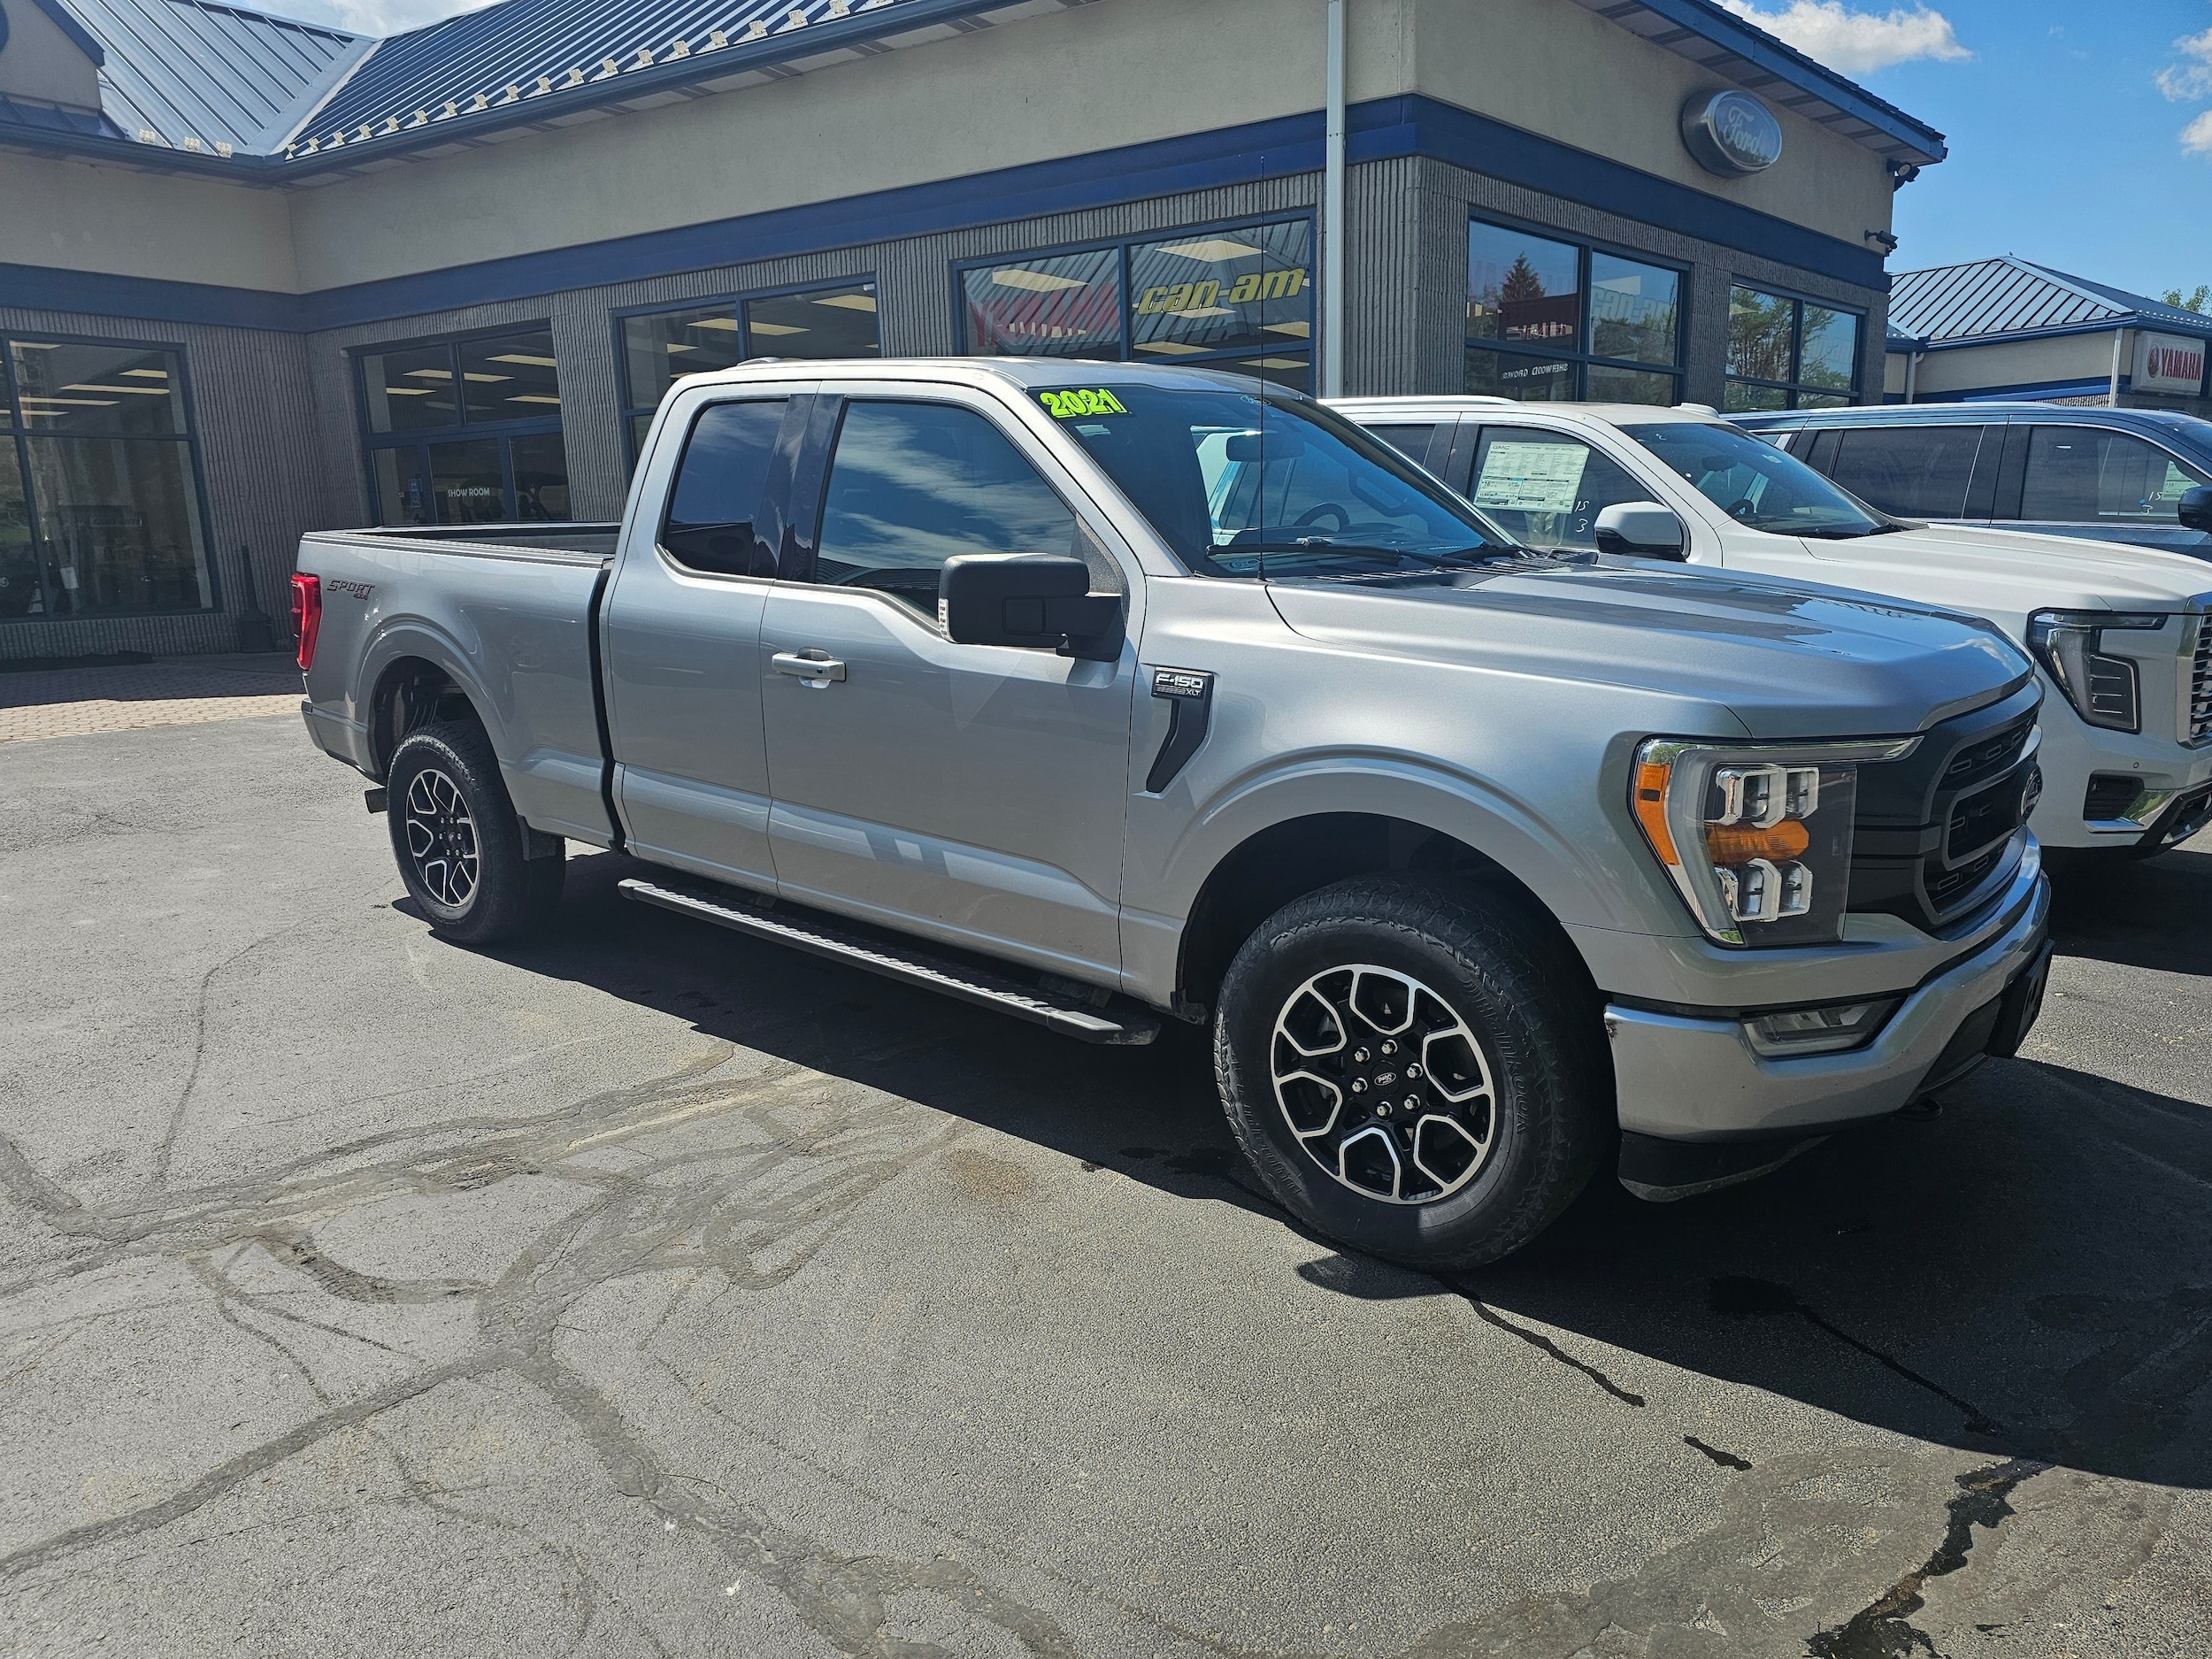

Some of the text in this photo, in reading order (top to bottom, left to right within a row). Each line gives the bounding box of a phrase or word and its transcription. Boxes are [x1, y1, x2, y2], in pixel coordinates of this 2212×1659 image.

[1723, 106, 1763, 156] Ford
[2162, 347, 2200, 380] YAMAHA
[1040, 388, 1128, 419] 2021
[448, 488, 490, 497] SHOW ROOM
[1575, 518, 1588, 533] 3
[326, 580, 376, 595] SPORT
[1156, 673, 1204, 689] F-150
